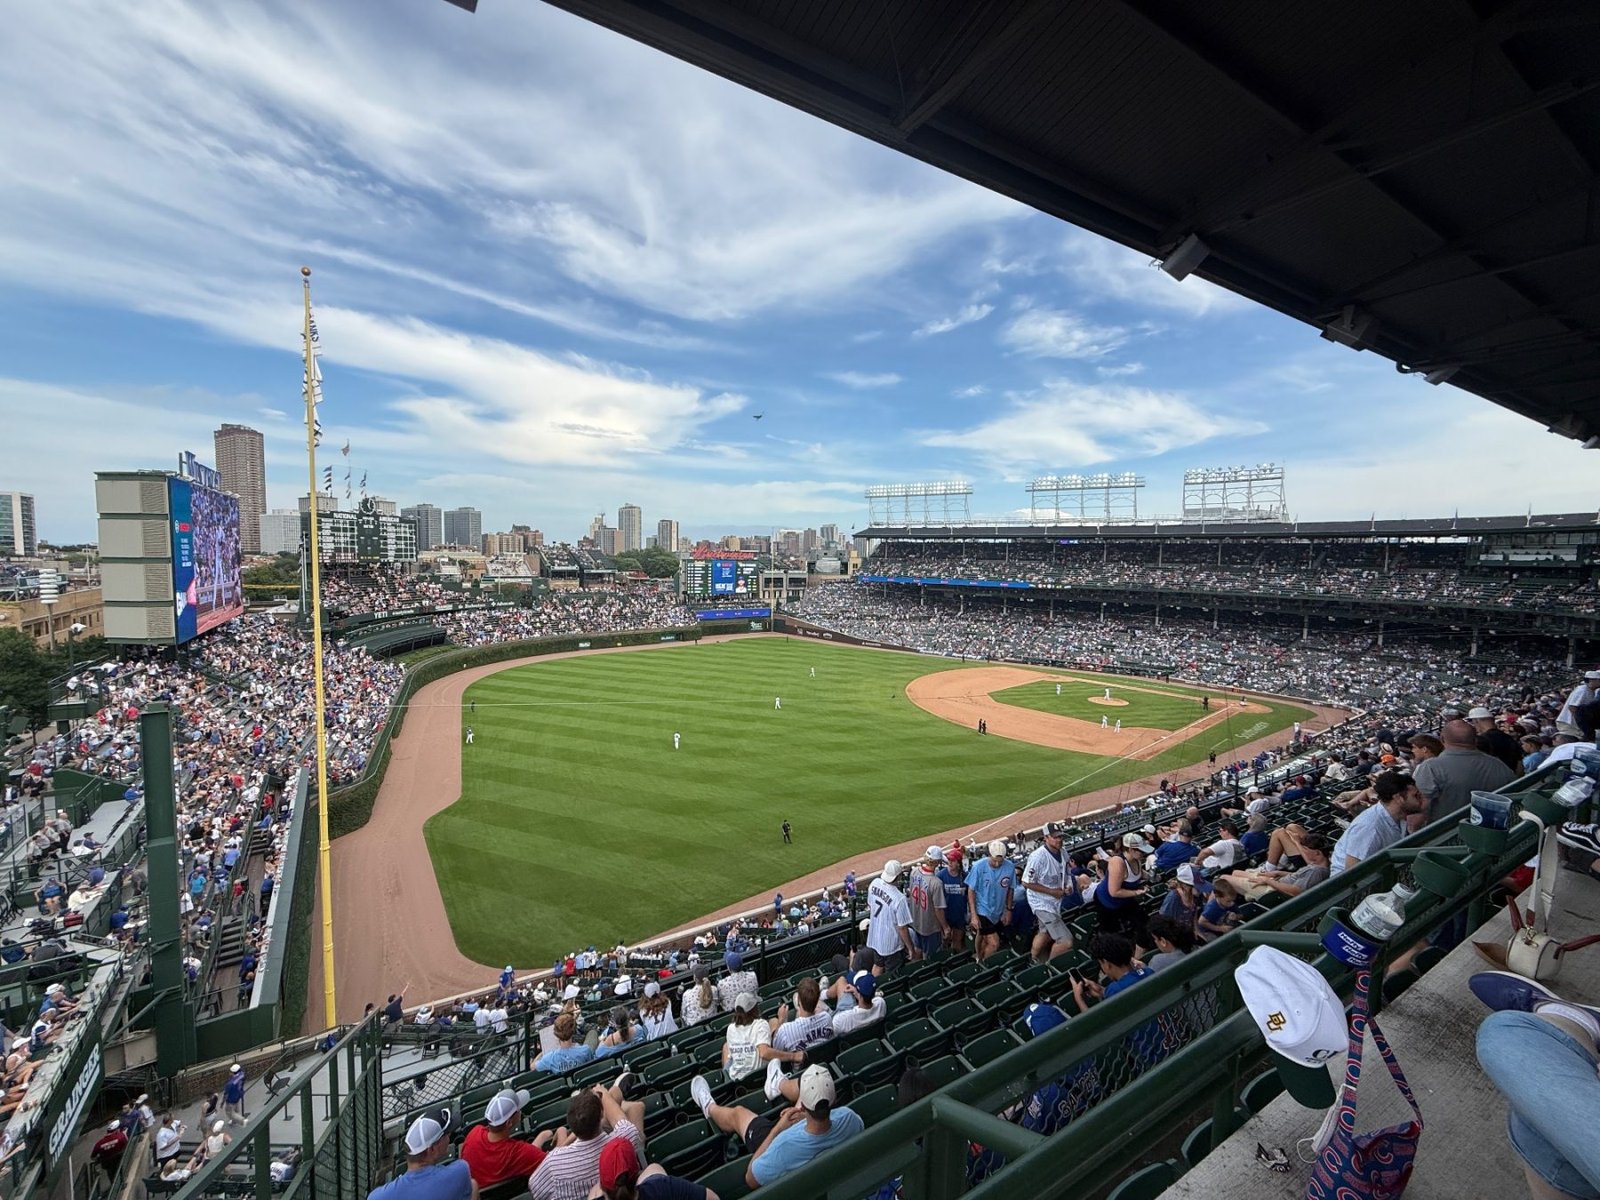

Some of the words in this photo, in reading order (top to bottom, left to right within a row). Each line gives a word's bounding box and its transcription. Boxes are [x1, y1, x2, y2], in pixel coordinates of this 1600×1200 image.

[333, 512, 358, 520] NATIONAL
[374, 611, 388, 619] YETI
[873, 900, 883, 918] 7
[48, 1042, 101, 1155] GRAINGER
